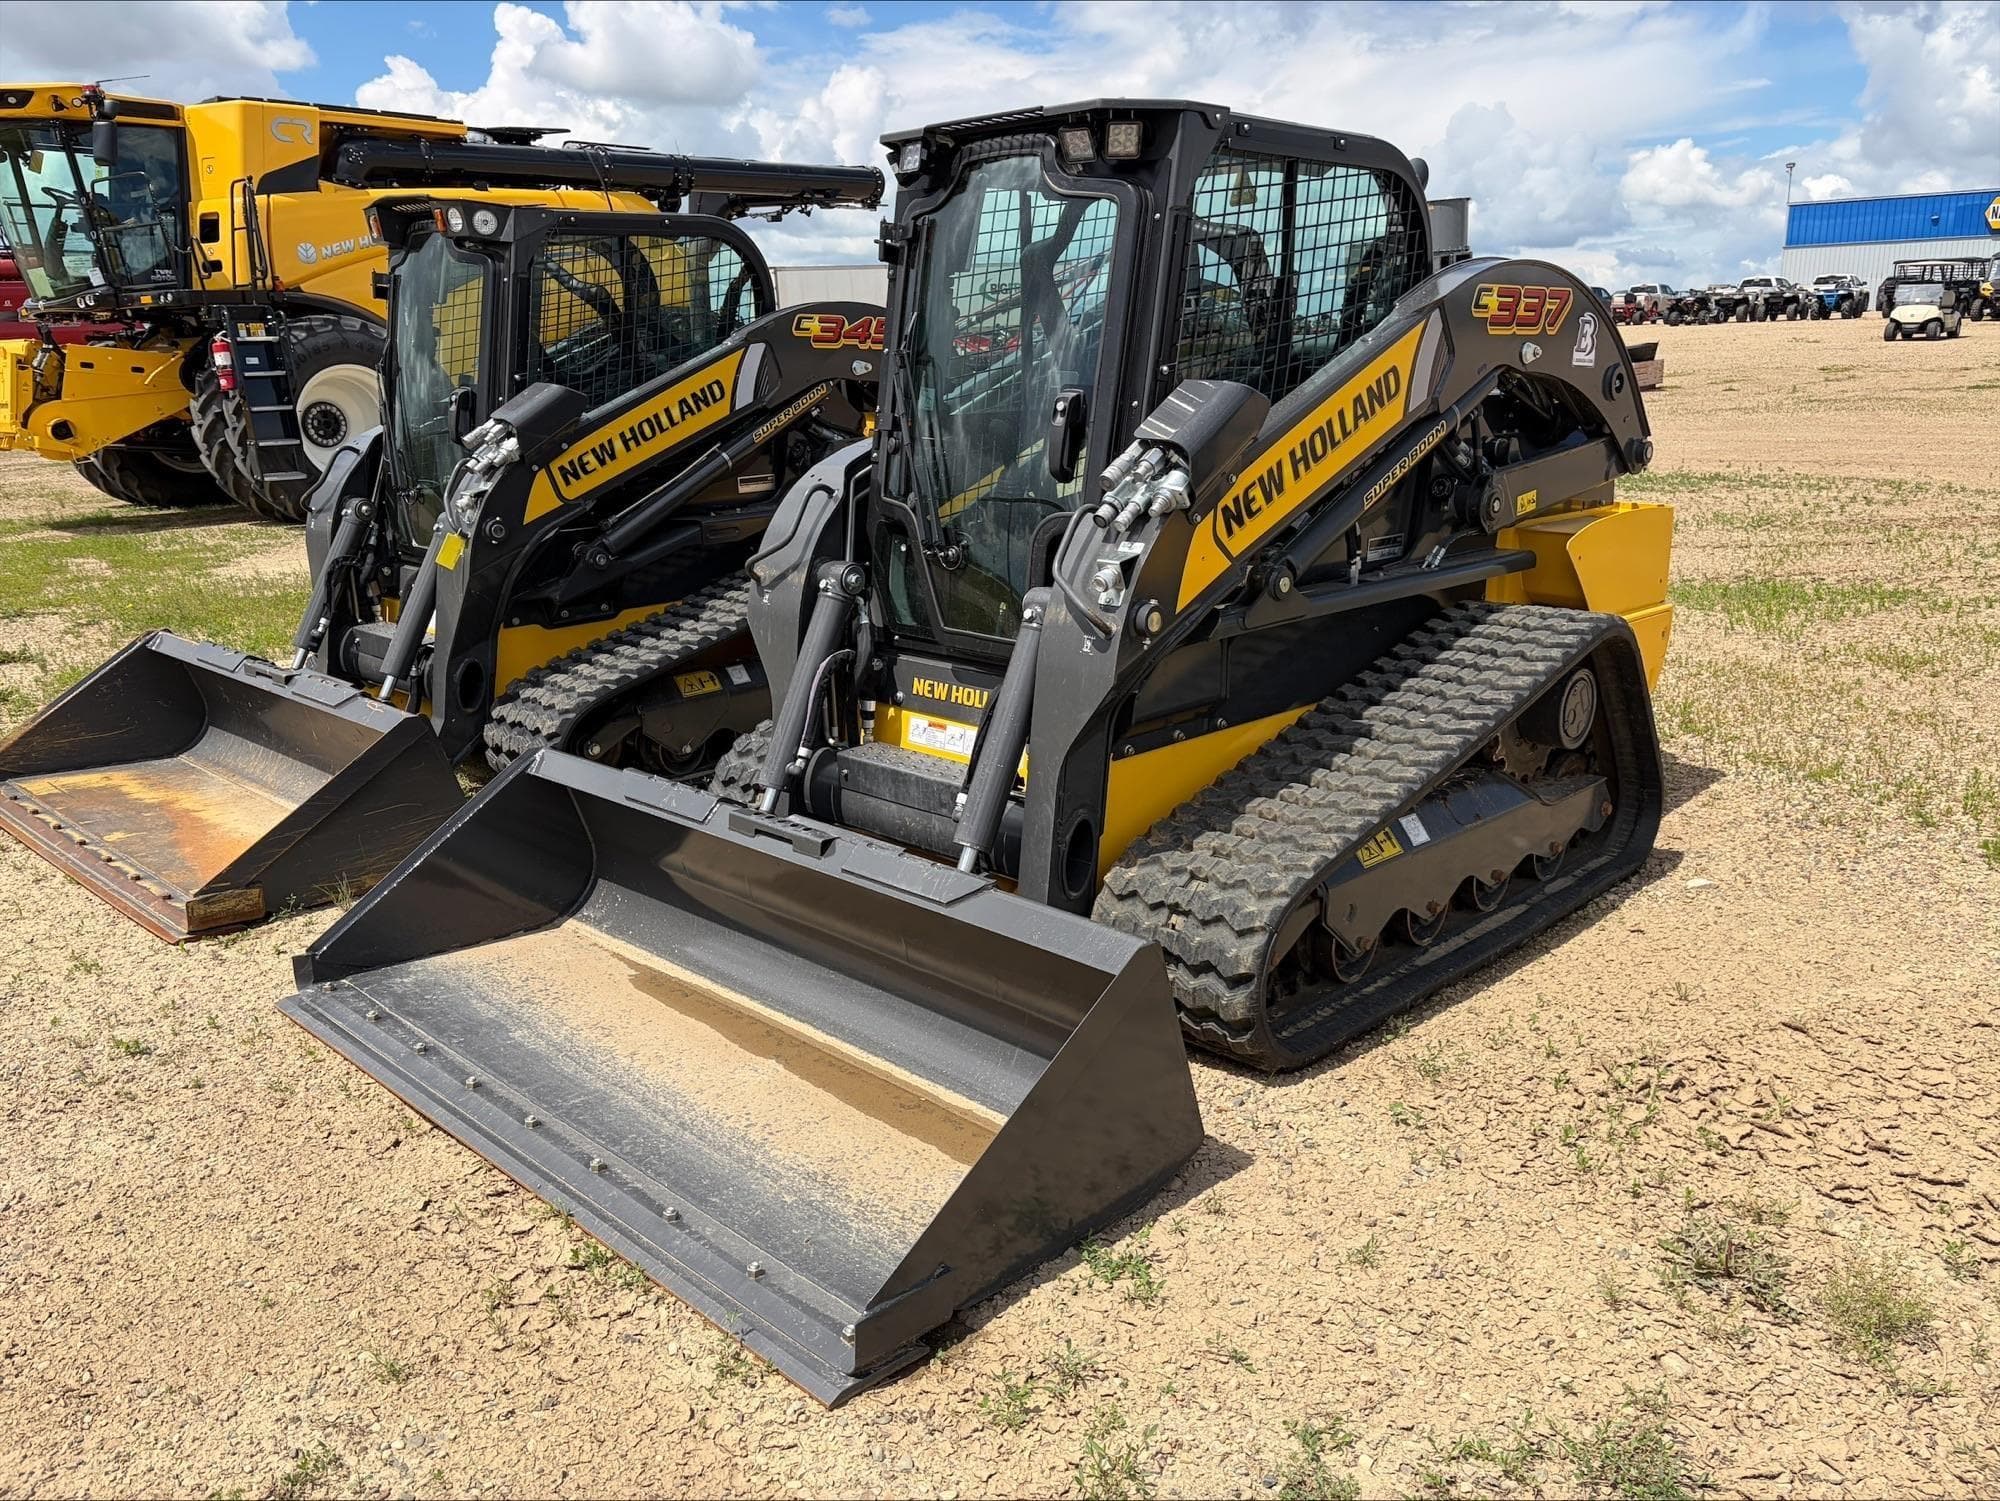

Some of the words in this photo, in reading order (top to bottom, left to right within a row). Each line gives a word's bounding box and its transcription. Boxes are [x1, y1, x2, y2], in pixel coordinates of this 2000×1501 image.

[271, 117, 313, 145] CR
[321, 239, 355, 259] NEW
[1471, 283, 1573, 335] C337
[557, 436, 618, 487] NEW
[618, 378, 726, 453] HOLLAND
[753, 407, 793, 443] SUPER
[791, 383, 827, 415] BOOM
[1220, 458, 1285, 540] NEW
[1288, 364, 1401, 482] HOLLAND
[1363, 457, 1409, 511] SUPER
[1408, 420, 1447, 467] BOOM
[912, 677, 949, 702] NEW
